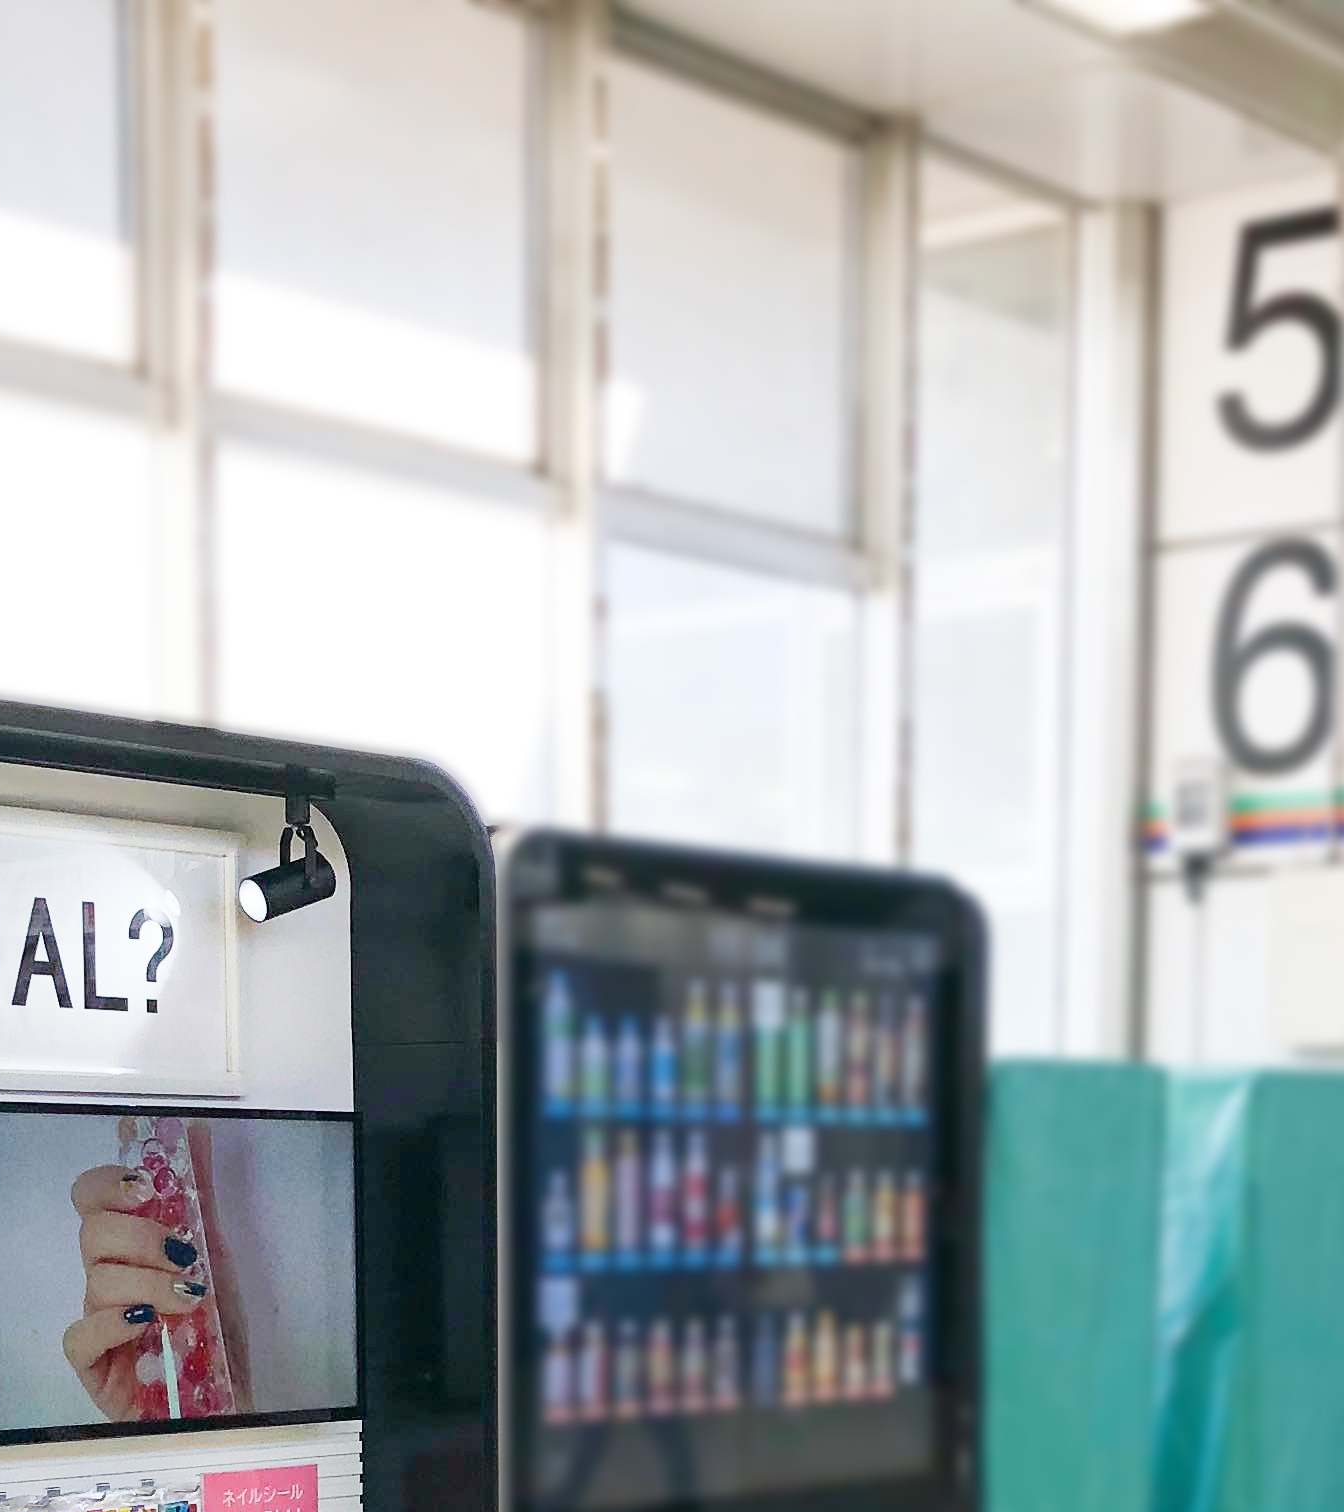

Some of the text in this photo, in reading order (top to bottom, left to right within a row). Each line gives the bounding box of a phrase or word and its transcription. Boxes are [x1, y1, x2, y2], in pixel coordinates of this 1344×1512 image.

[1212, 537, 1339, 777] 6
[222, 1484, 304, 1507] ネイルシール
